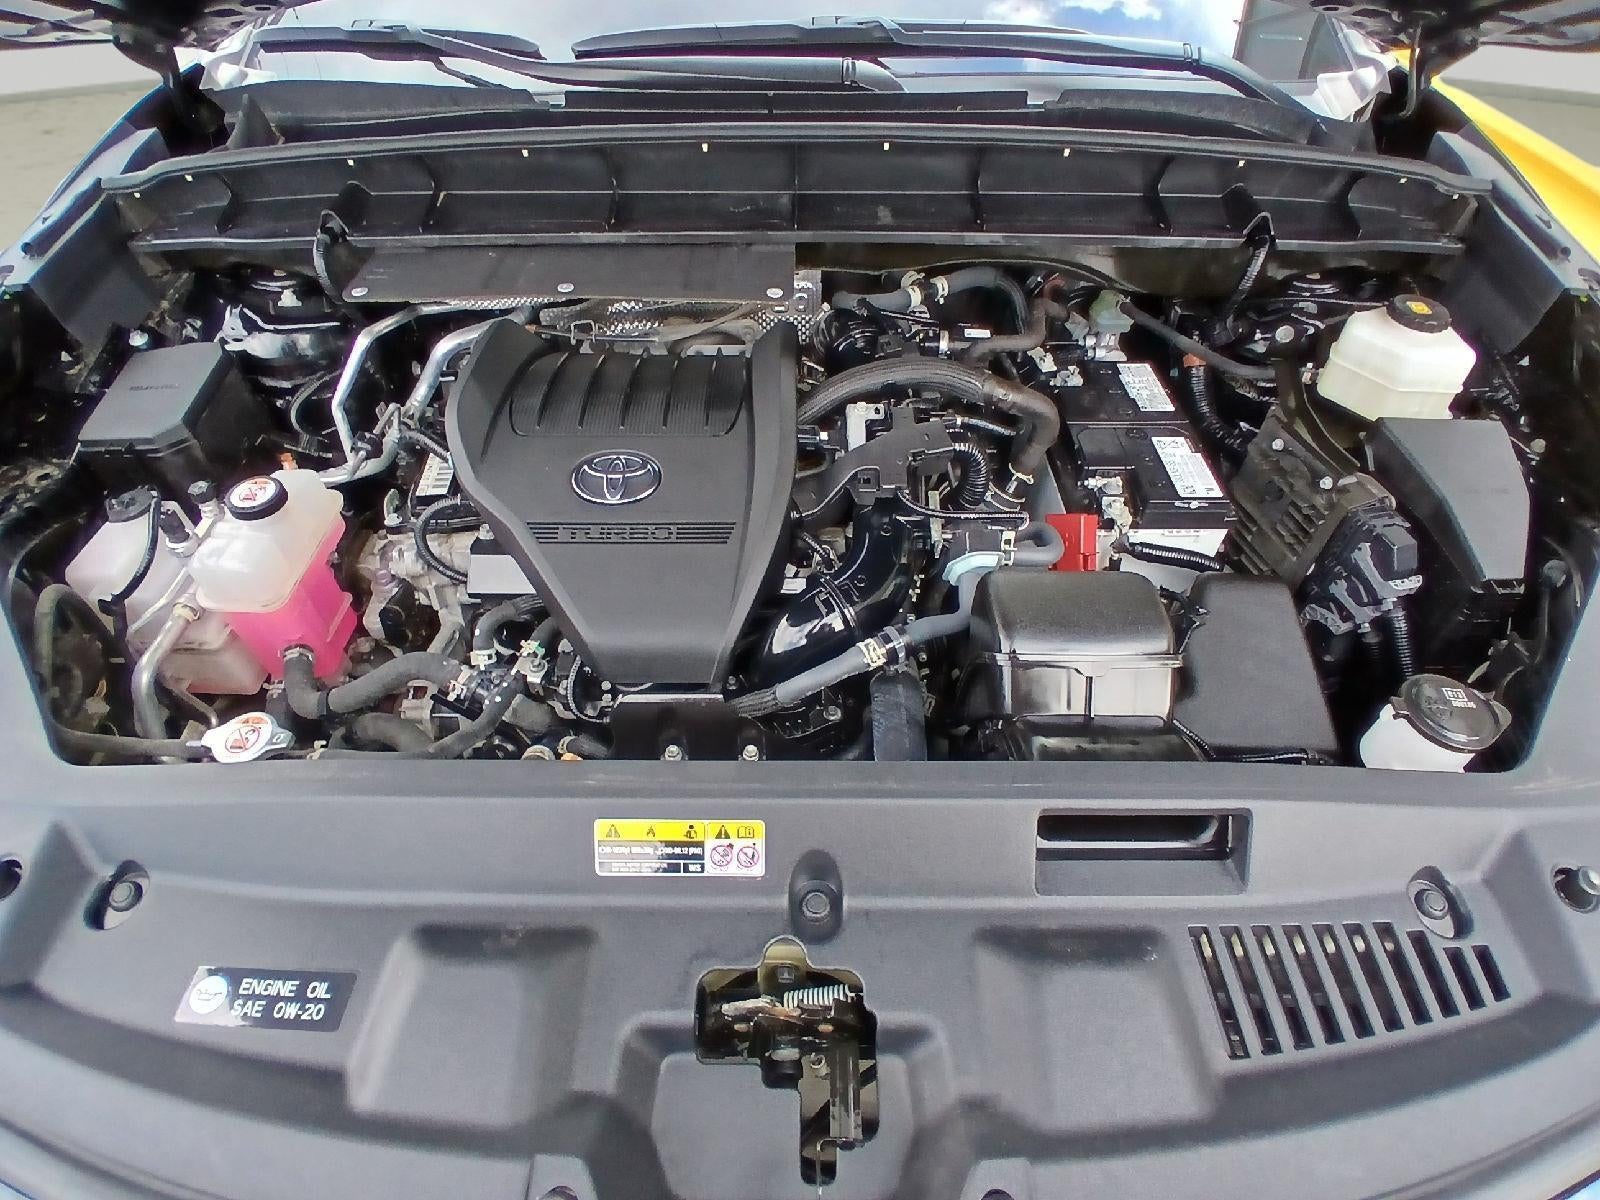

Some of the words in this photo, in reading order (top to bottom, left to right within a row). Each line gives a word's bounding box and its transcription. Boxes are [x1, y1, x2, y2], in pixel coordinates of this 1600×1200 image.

[558, 526, 676, 542] TURBO
[239, 978, 300, 997] ENGINE
[306, 981, 331, 999] OIL
[230, 999, 266, 1017] SAE
[273, 1001, 325, 1020] 0W-20
